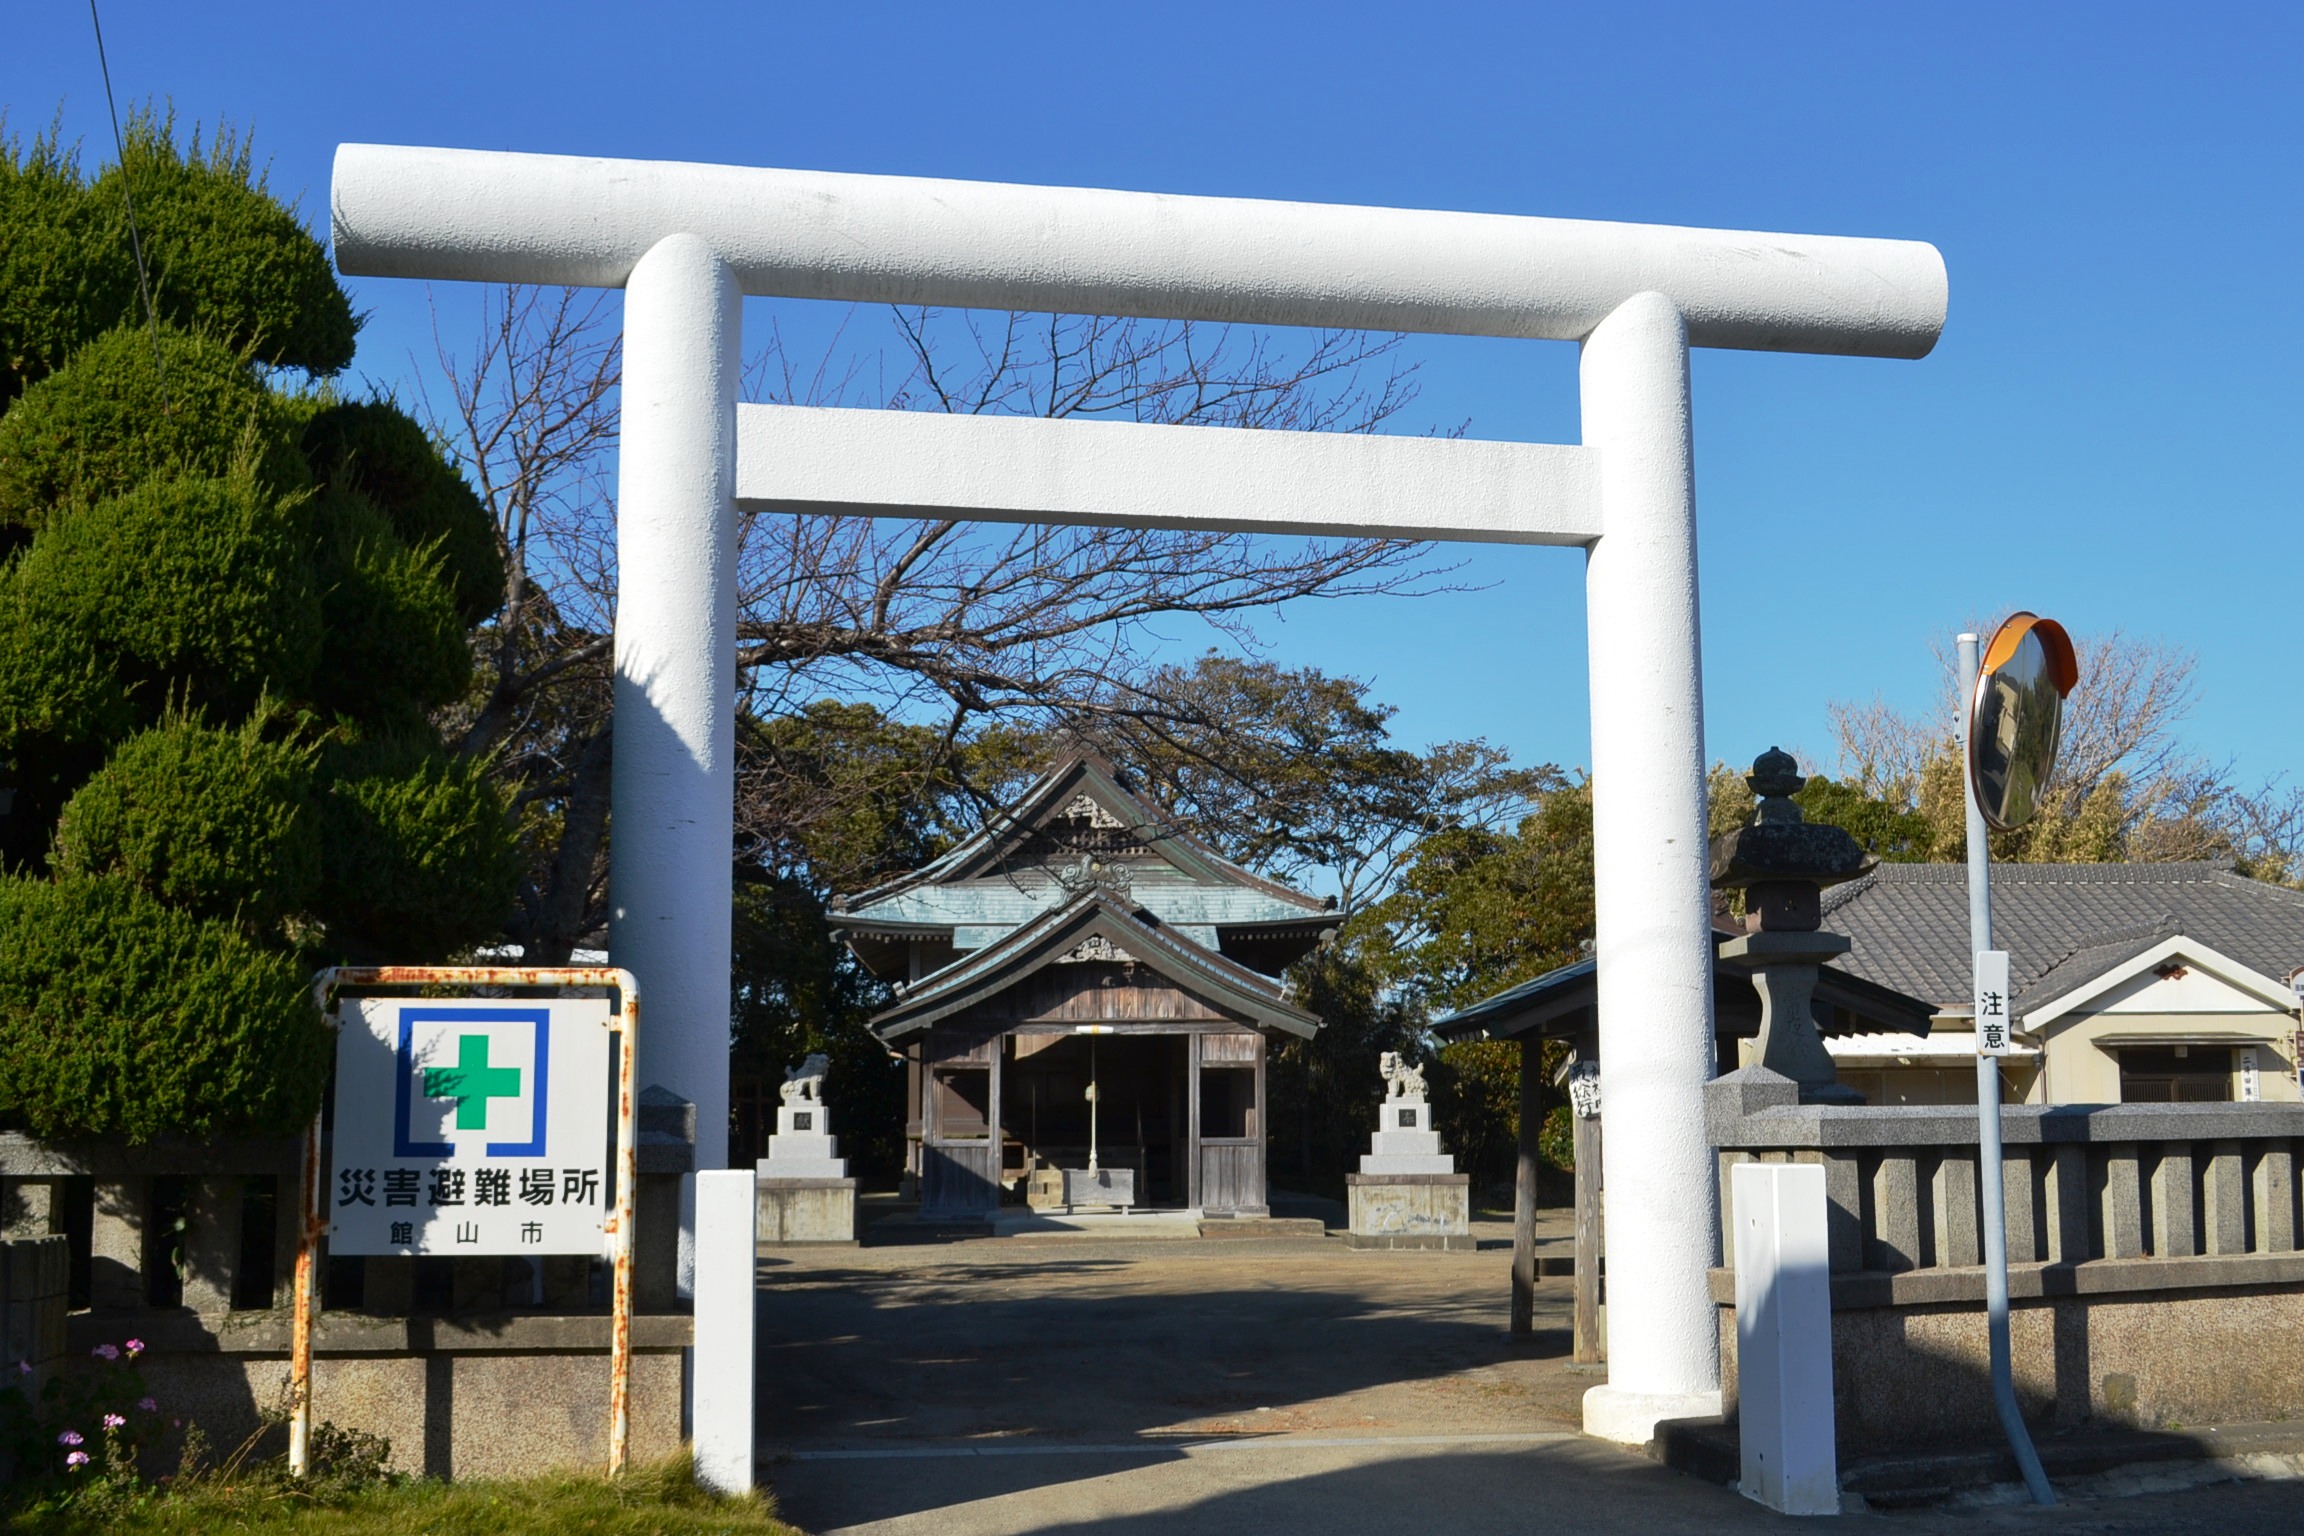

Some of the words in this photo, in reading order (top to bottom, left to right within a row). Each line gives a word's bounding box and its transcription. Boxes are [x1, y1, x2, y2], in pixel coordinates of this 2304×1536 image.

[1981, 991, 2005, 1049] 注意
[338, 1168, 599, 1207] 災害避難場所
[390, 1221, 543, 1244] 館山市
